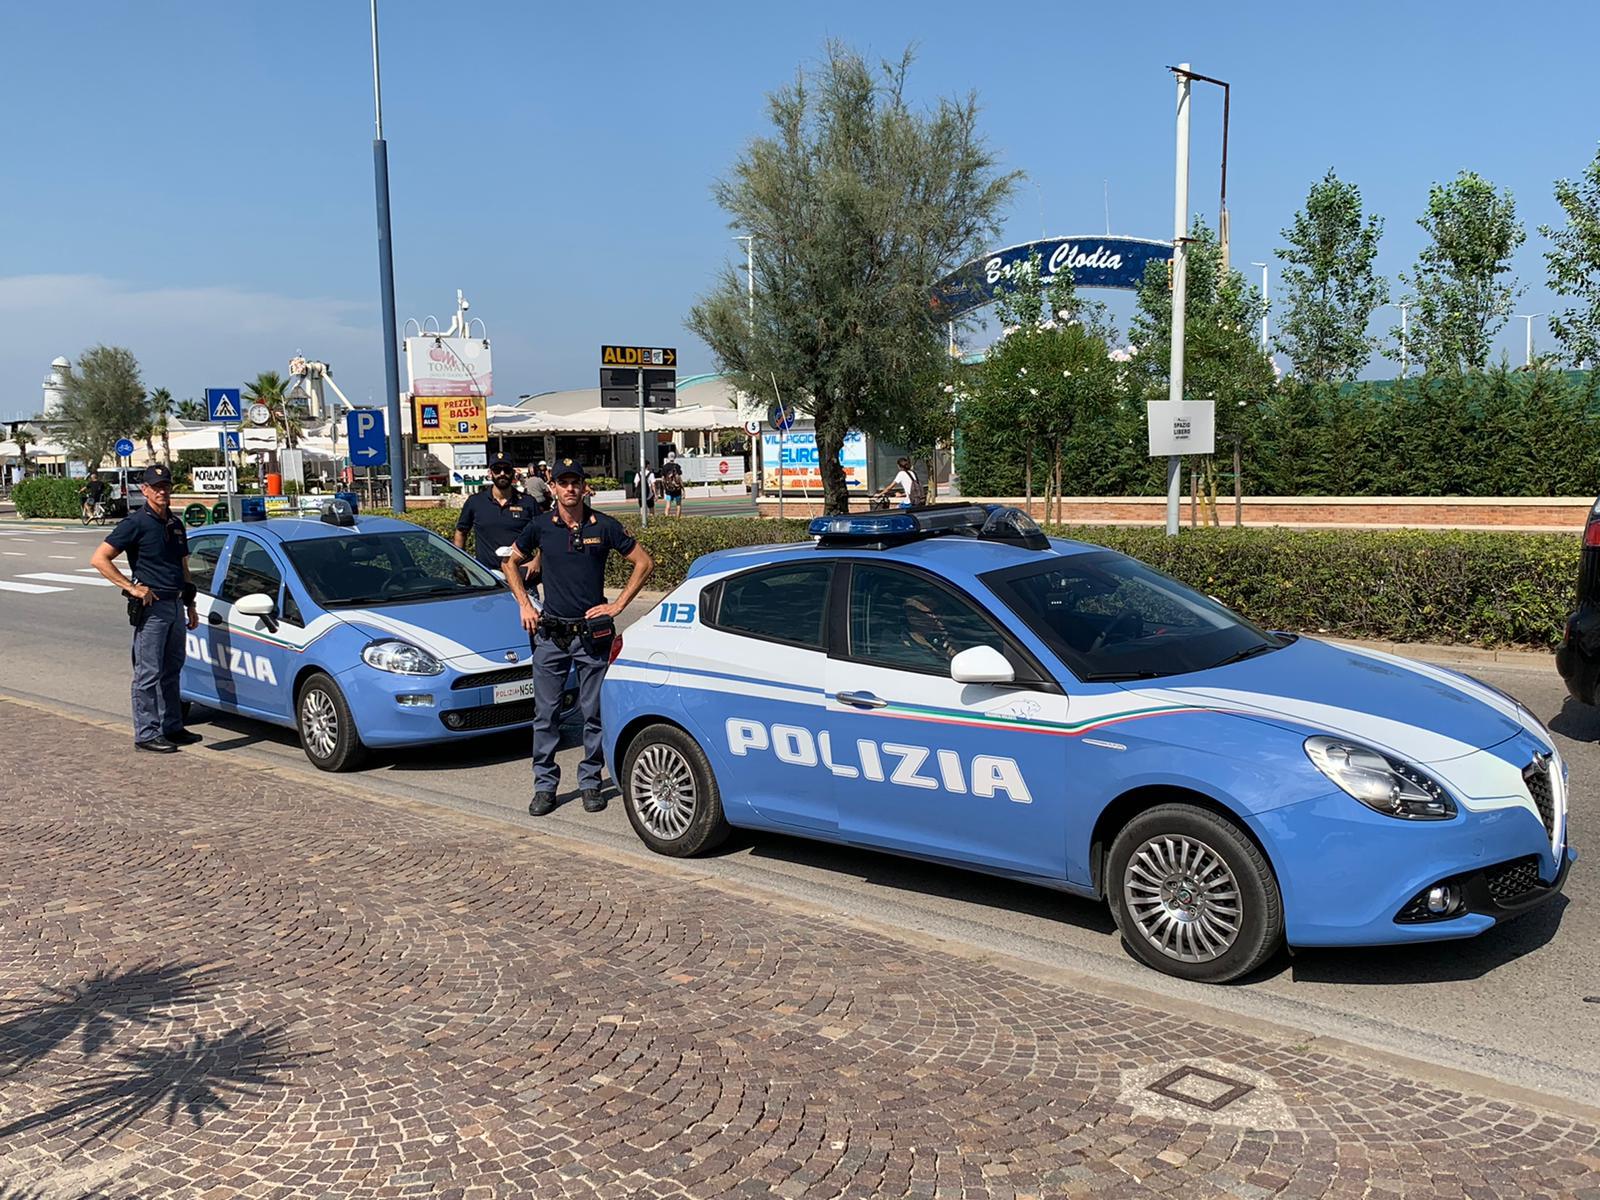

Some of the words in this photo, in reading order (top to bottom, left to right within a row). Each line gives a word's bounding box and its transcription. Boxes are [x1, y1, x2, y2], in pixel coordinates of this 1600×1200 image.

[1048, 242, 1124, 275] Clodia
[603, 347, 641, 364] ALDI
[427, 362, 475, 372] TOMATO
[444, 399, 472, 408] PREZZI
[449, 407, 479, 418] BASSI
[357, 413, 375, 438] P
[460, 422, 468, 432] P
[659, 603, 697, 623] 113
[185, 632, 278, 686] OLIZIA
[725, 716, 1033, 804] POLIZIA
